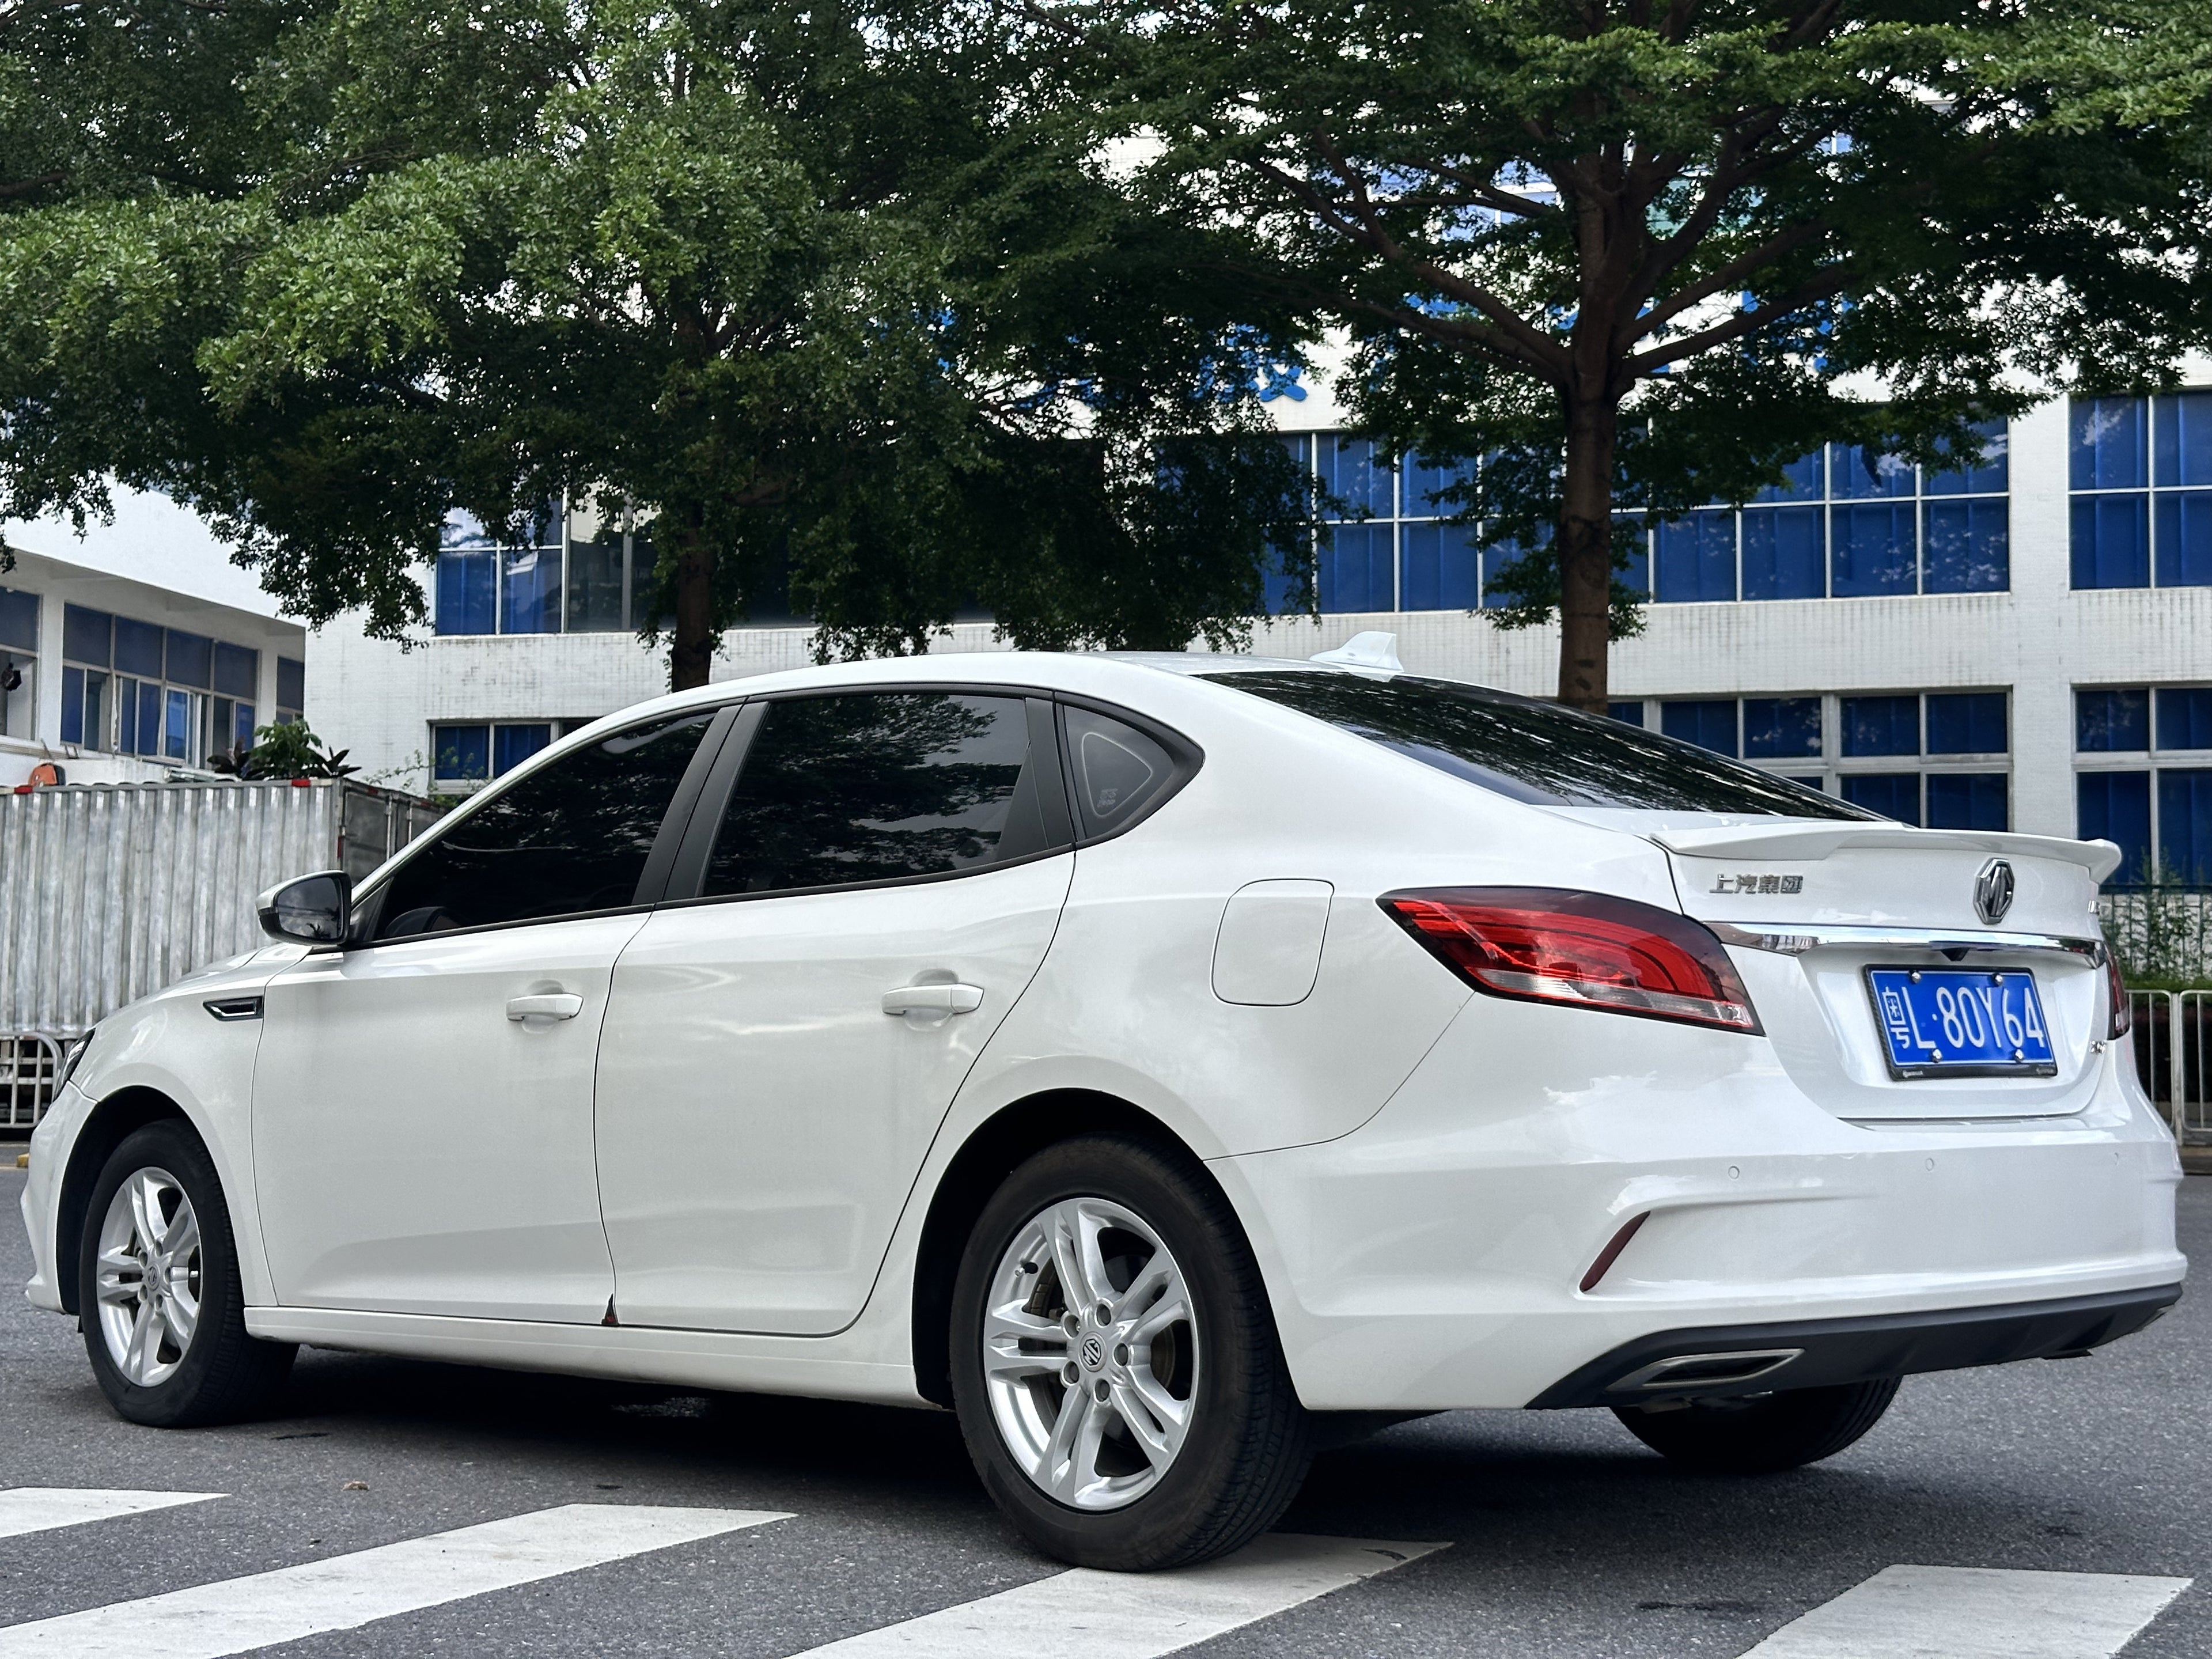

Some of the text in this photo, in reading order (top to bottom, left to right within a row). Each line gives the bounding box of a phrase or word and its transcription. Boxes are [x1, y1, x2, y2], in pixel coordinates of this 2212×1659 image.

[1709, 874, 1803, 894] 上汽集团
[1083, 1339, 1101, 1365] MG
